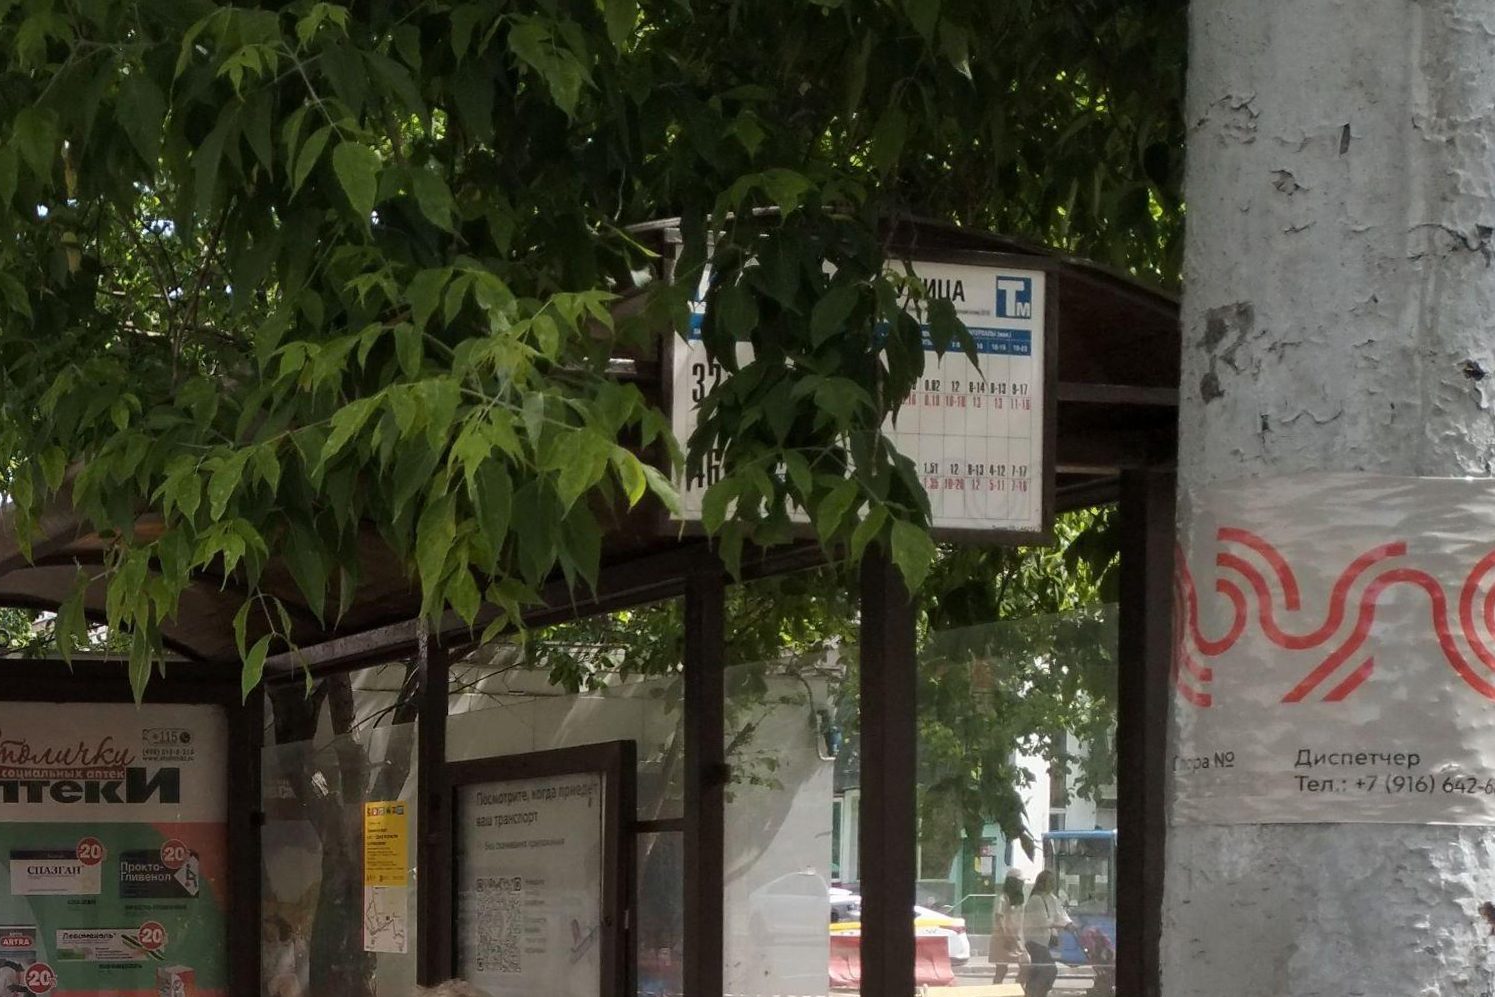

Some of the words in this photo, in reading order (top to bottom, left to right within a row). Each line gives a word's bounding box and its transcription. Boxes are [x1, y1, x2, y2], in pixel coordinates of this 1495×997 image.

[895, 277, 966, 302] УИЦА
[951, 381, 960, 392] 12
[950, 464, 959, 475] 12
[1294, 749, 1421, 769] Диспетчер
[2, 767, 83, 780] социальных
[85, 768, 125, 779] аптек
[1294, 775, 1348, 792] Тел.:
[1355, 775, 1377, 792] +7
[1386, 775, 1435, 794] (916)
[1442, 777, 1495, 795] 642-6
[531, 786, 556, 801] когда
[493, 811, 538, 828] транспорт
[26, 865, 81, 875] СПАЗГАН
[120, 861, 165, 873] Прокто-
[120, 872, 171, 882] Гливенол
